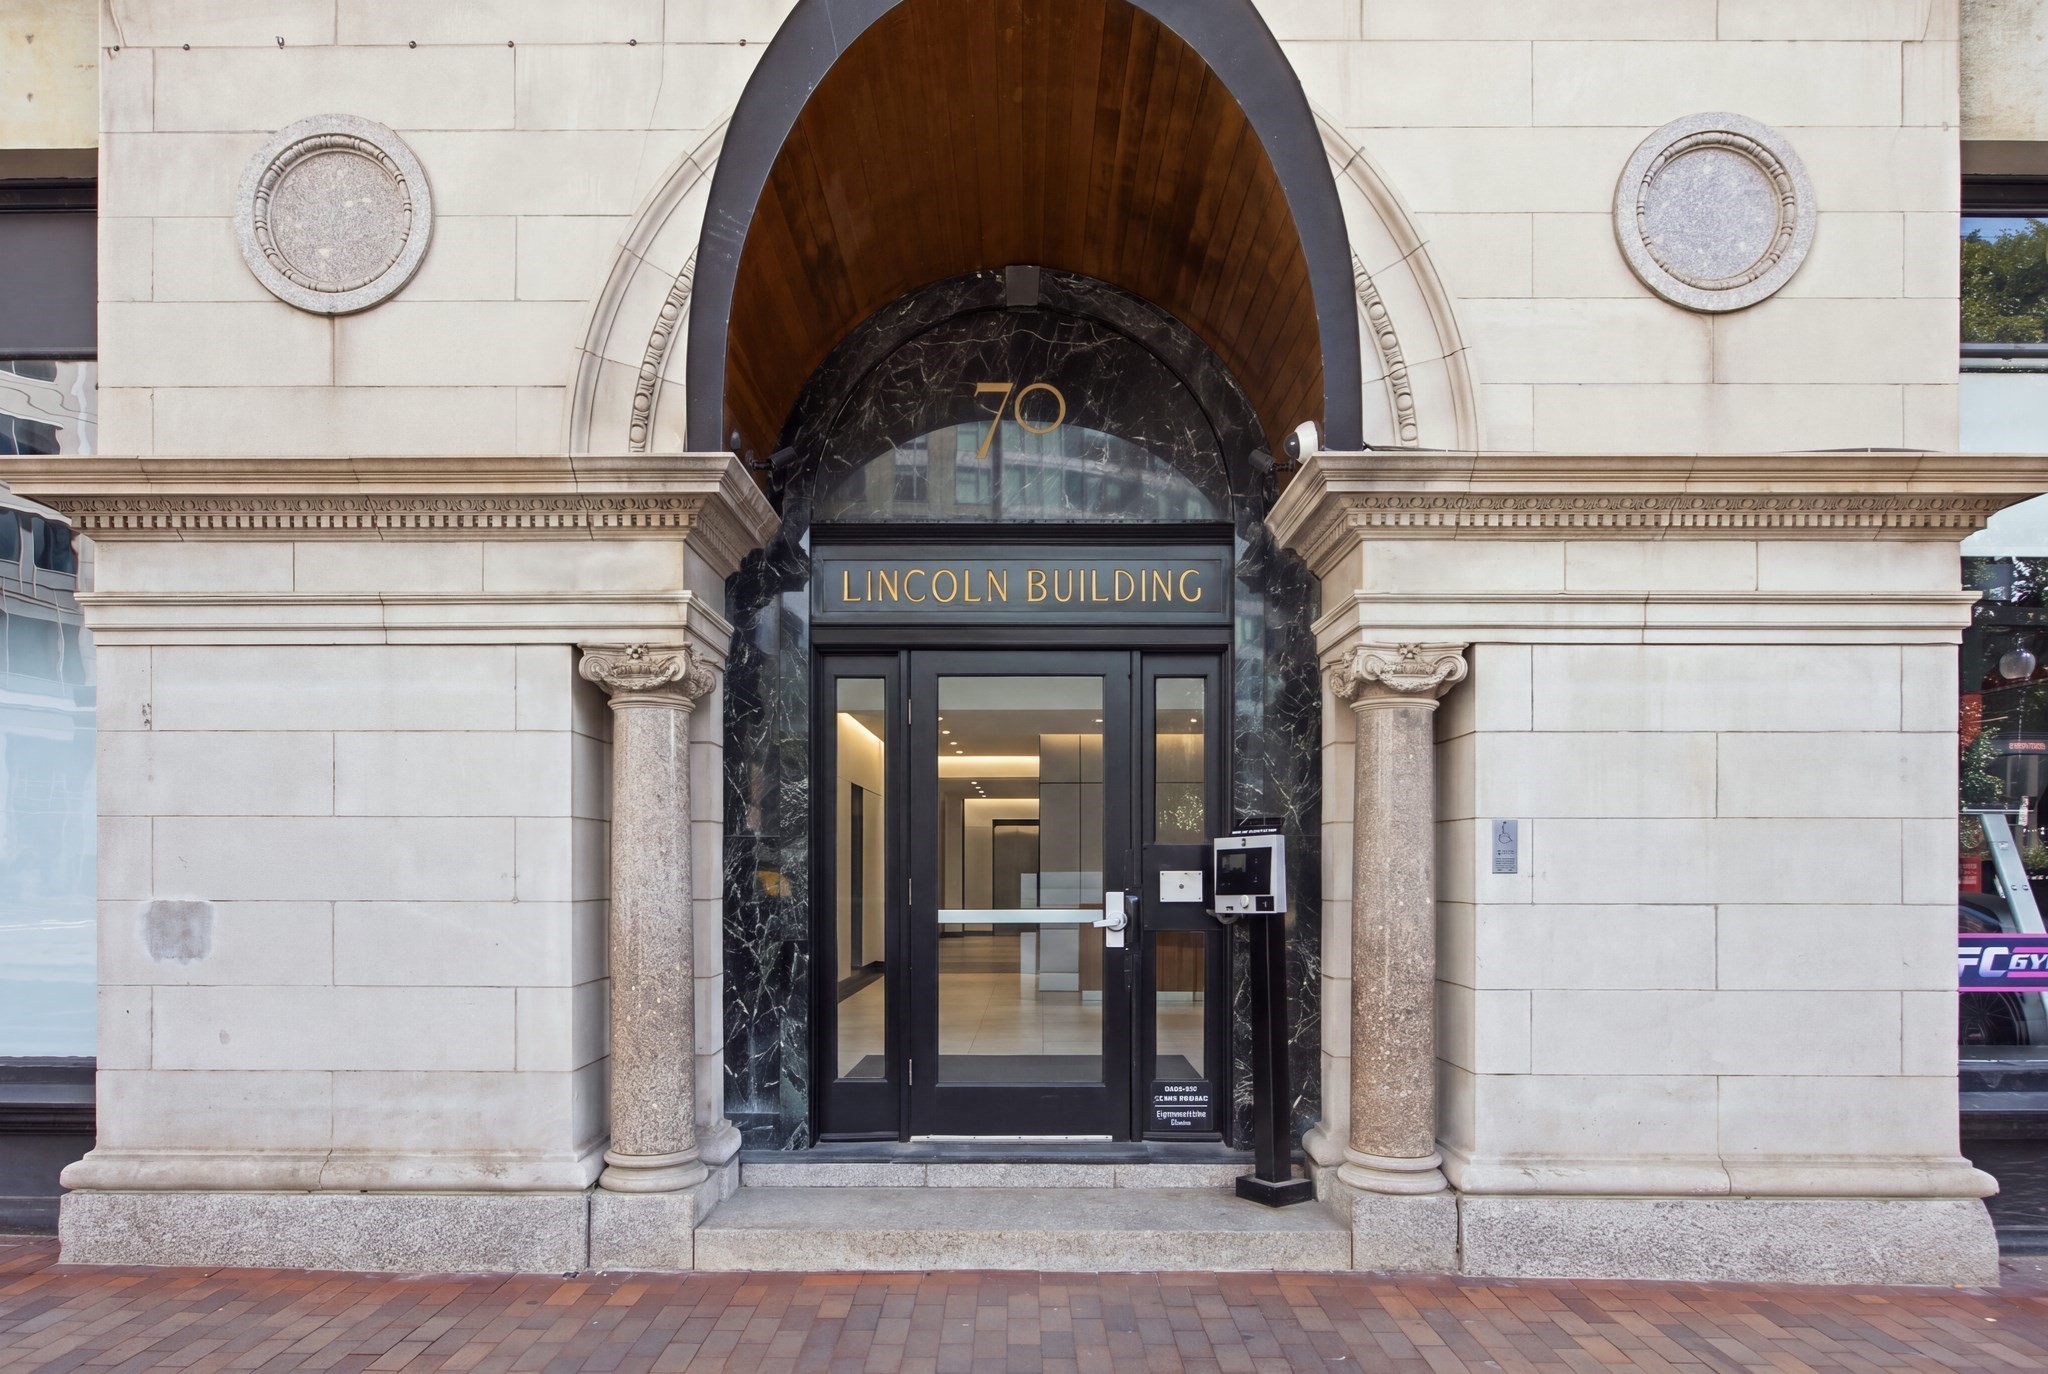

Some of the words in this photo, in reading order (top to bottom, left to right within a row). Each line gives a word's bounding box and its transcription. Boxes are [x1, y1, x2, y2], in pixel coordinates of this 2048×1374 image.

[974, 382, 1066, 459] 70
[842, 569, 1008, 603] LINCOLN
[1027, 569, 1202, 603] BUILDING
[2008, 954, 2048, 969] GY
